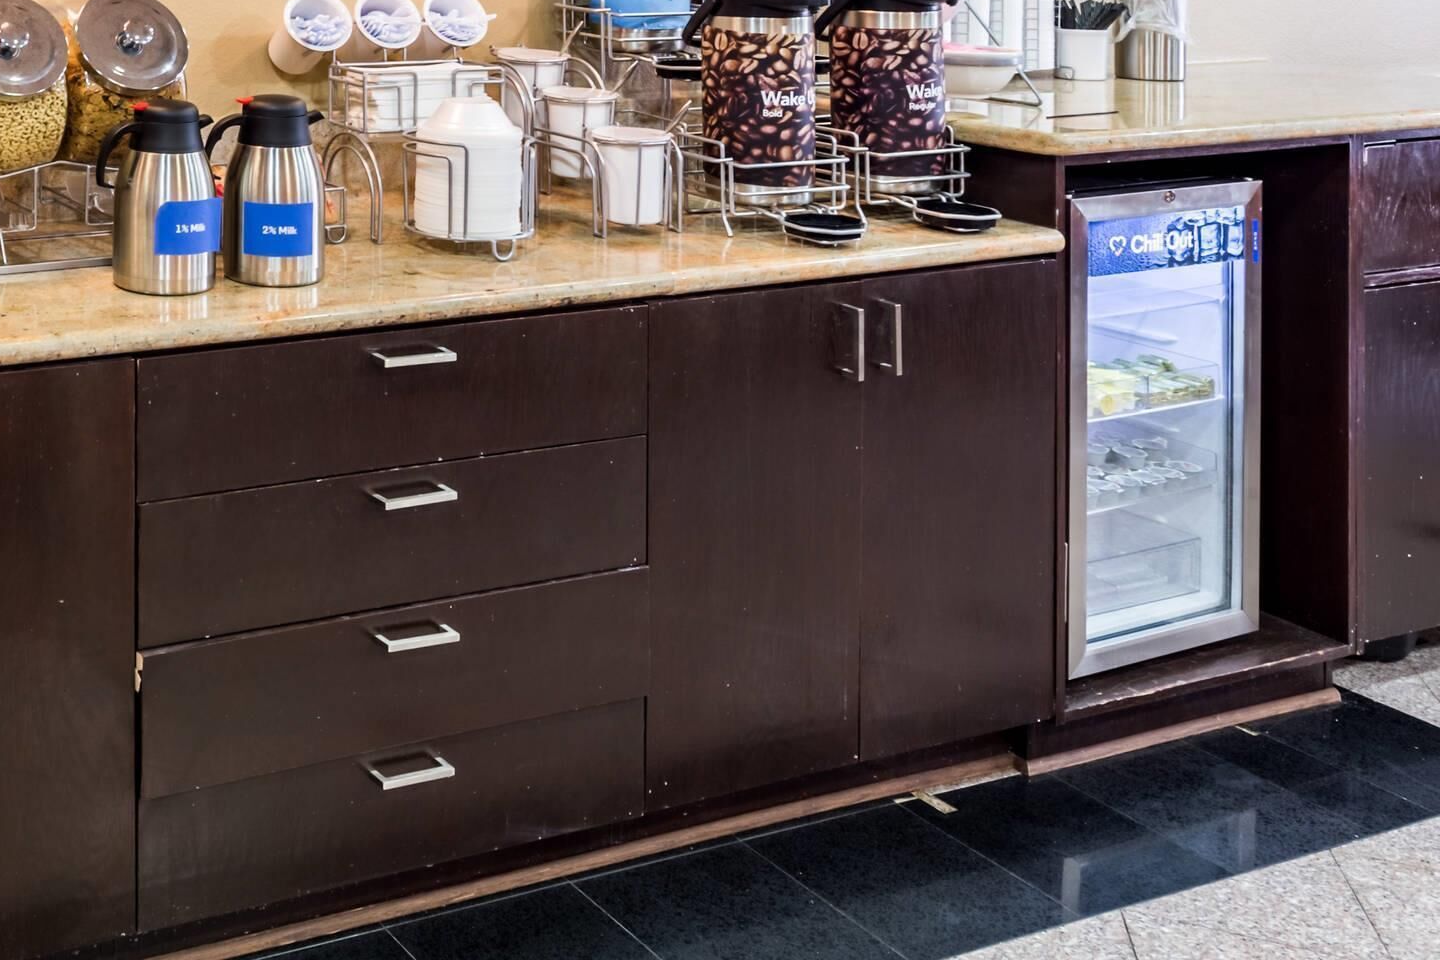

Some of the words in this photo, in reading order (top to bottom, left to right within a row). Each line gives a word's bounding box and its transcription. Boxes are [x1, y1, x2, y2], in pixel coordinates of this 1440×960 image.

[760, 90, 806, 107] Wake
[905, 83, 942, 100] Wake
[762, 108, 784, 118] Bold
[175, 224, 189, 234] 1%
[190, 223, 206, 233] Milk
[262, 225, 277, 235] 2%
[278, 225, 298, 235] Milk
[1130, 233, 1164, 254] Chill
[1167, 230, 1194, 250] Out
